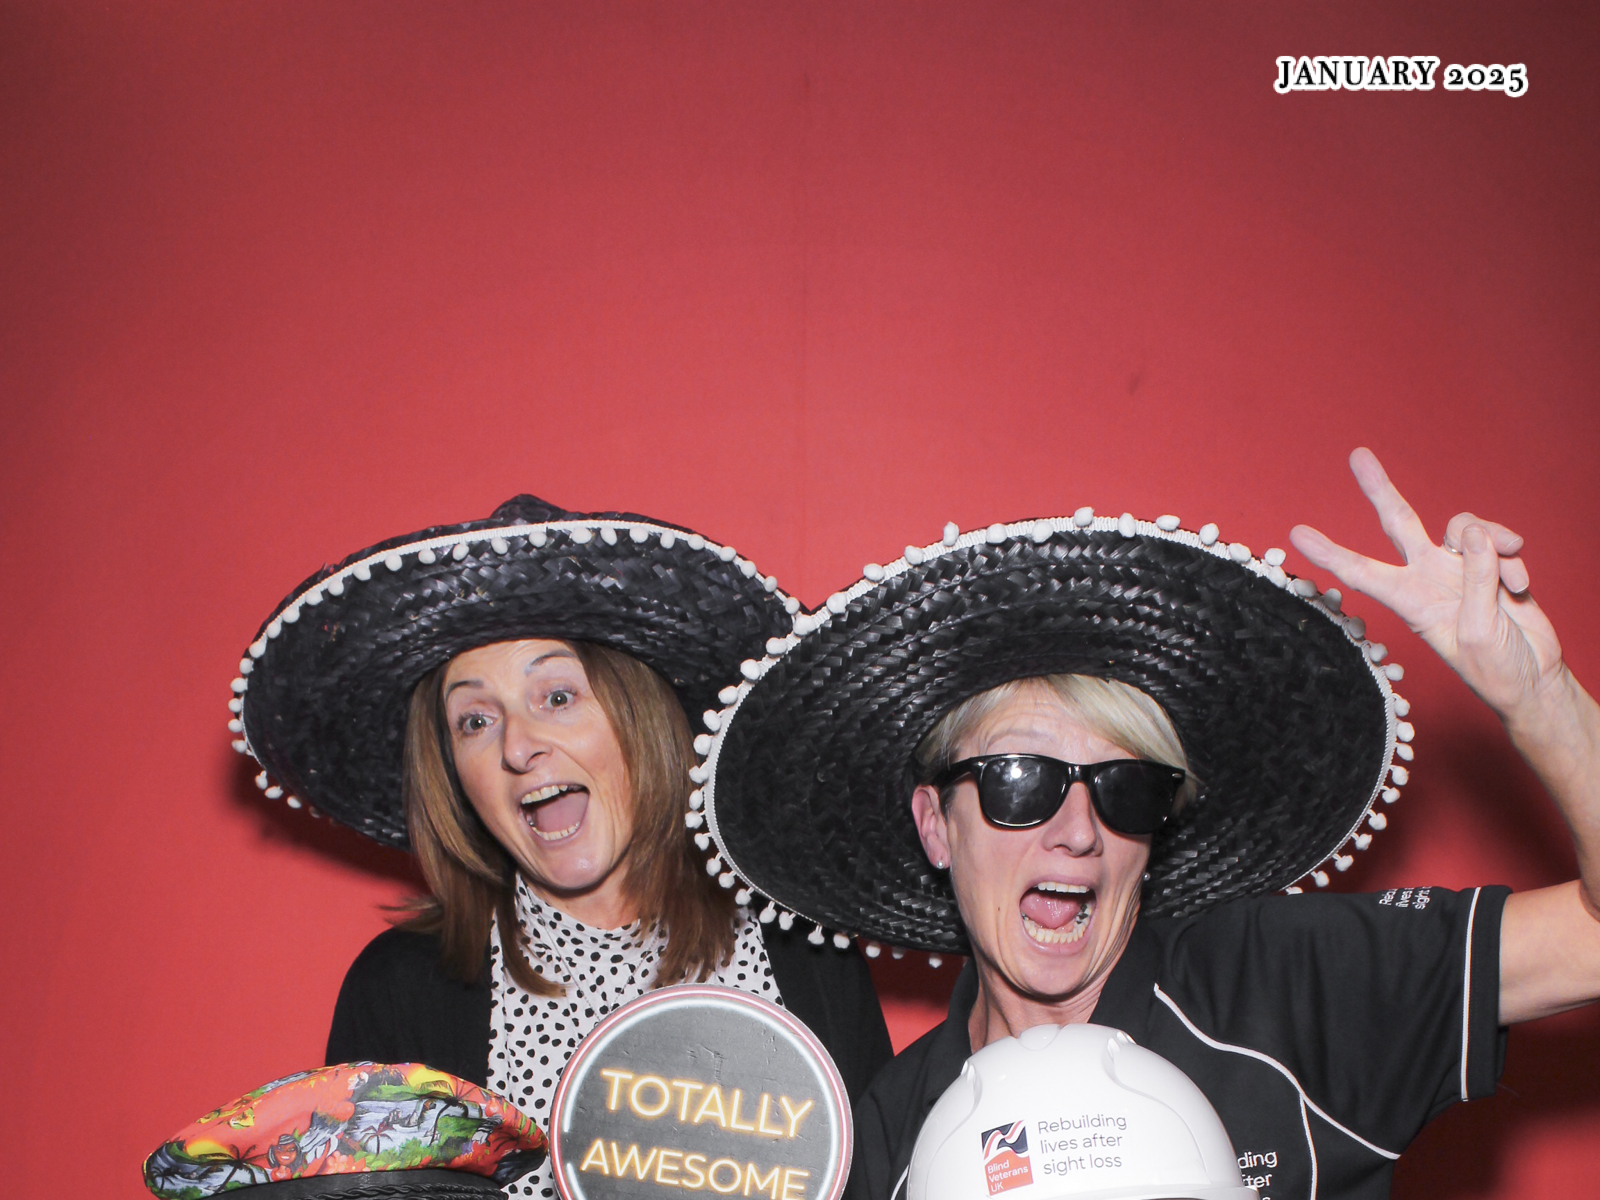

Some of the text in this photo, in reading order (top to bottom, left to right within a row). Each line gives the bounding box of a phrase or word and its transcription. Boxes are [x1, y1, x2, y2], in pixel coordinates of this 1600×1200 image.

[601, 1069, 812, 1138] TOTALLY
[1038, 1114, 1127, 1134] Rebuilding
[1040, 1133, 1123, 1154] lives after
[987, 1159, 1010, 1174] Blind
[988, 1165, 1029, 1183] Veterans
[1043, 1154, 1123, 1176] sight loss
[990, 1181, 1004, 1193] UK
